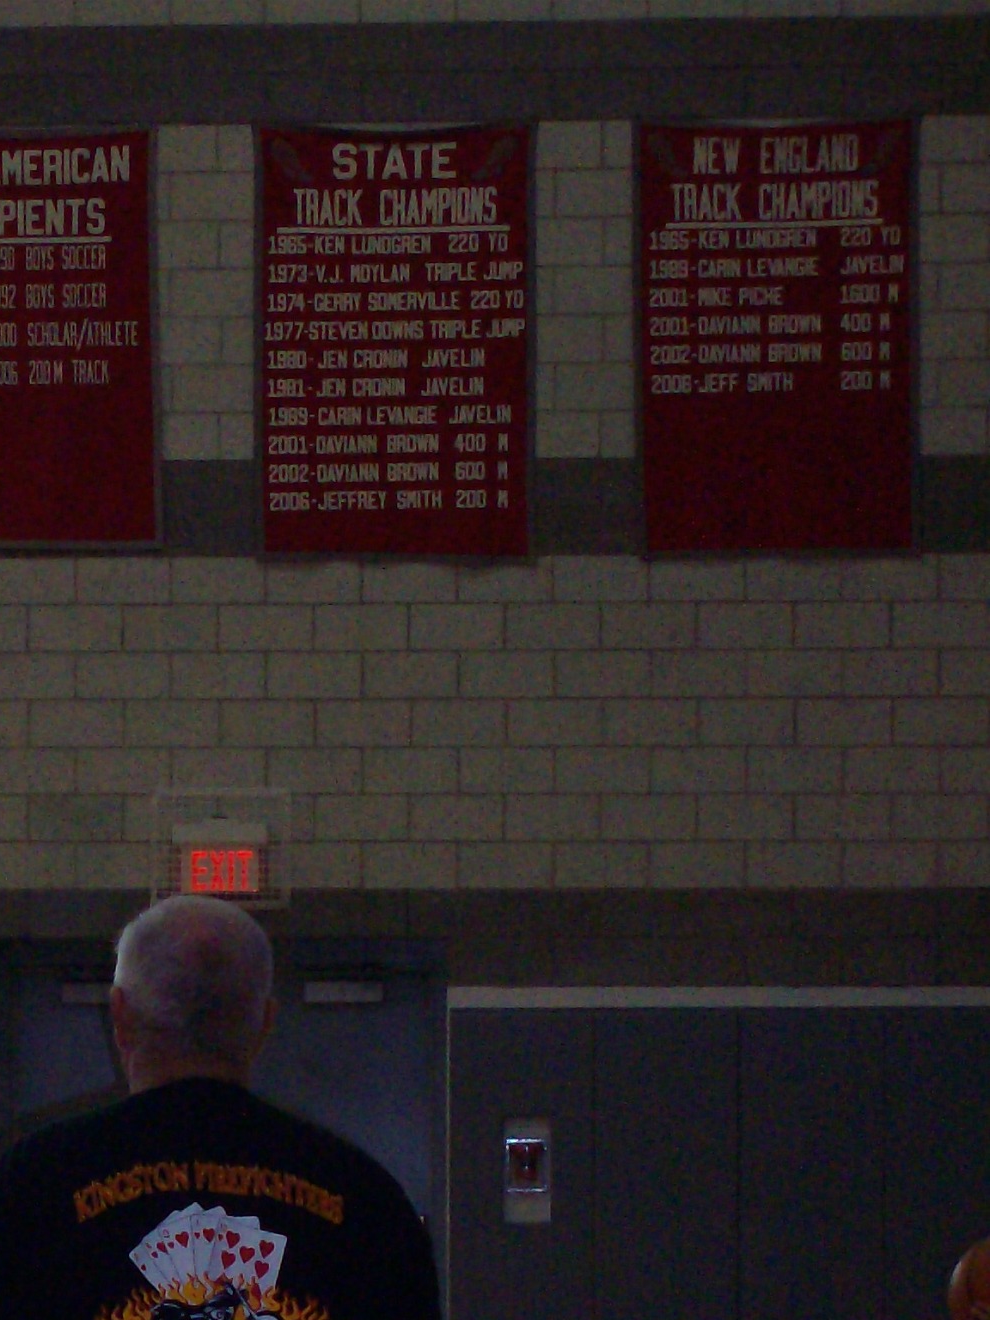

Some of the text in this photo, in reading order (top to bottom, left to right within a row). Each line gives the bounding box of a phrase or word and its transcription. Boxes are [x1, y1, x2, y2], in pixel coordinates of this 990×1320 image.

[332, 141, 457, 181] STATE
[693, 134, 859, 174] NEW ENGLAND
[293, 186, 498, 226] TRACK CHAMPIONS
[670, 179, 879, 221] TRACK CHAMPIONS
[351, 234, 432, 254] LUNDGREN
[448, 233, 479, 253] 220
[489, 233, 509, 252] YD
[735, 229, 817, 249] LUNDGREN
[840, 226, 871, 247] 220
[881, 225, 901, 246] YD
[25, 245, 55, 271] BOYS
[62, 244, 106, 271] SOCCER
[746, 256, 819, 278] LEVANGIE
[840, 254, 904, 276] JAVELIN
[350, 263, 410, 283] MOYLAN
[425, 262, 477, 282] TRIPLE
[483, 261, 523, 281] JUMP
[25, 283, 55, 309] BOYS
[62, 283, 107, 309] SOCCER
[367, 291, 461, 311] SOMERVILLE
[470, 290, 500, 310] 220
[505, 289, 524, 309] YD
[888, 284, 898, 303] M
[27, 316, 139, 351] SCHOLAR/ATHLETE
[371, 319, 424, 340] DOWNS
[429, 319, 481, 340] TRIPLE
[485, 318, 526, 338] JUMP
[768, 314, 822, 335] BROWN
[840, 313, 871, 333] 400
[879, 313, 890, 332] M
[352, 349, 408, 368] CRONIN
[421, 348, 485, 368] JAVELIN
[768, 343, 822, 363] BROWN
[879, 342, 890, 361] M
[72, 359, 110, 386] TRACK
[746, 372, 793, 393] SMITH
[840, 371, 872, 392] 200
[352, 377, 406, 397] CRONIN
[421, 376, 484, 397] JAVELIN
[366, 405, 438, 425] LEVANGIE
[448, 404, 512, 424] JAVELIN
[386, 433, 439, 454] BROWN
[454, 433, 486, 453] 400
[497, 433, 508, 452] M
[386, 462, 439, 482] BROWN
[454, 461, 486, 481] 600
[497, 461, 508, 480] M
[396, 489, 443, 510] SMITH
[455, 489, 487, 509] 200
[497, 489, 508, 509] M
[191, 851, 253, 891] EXIT
[72, 1160, 189, 1223] KINGSTON
